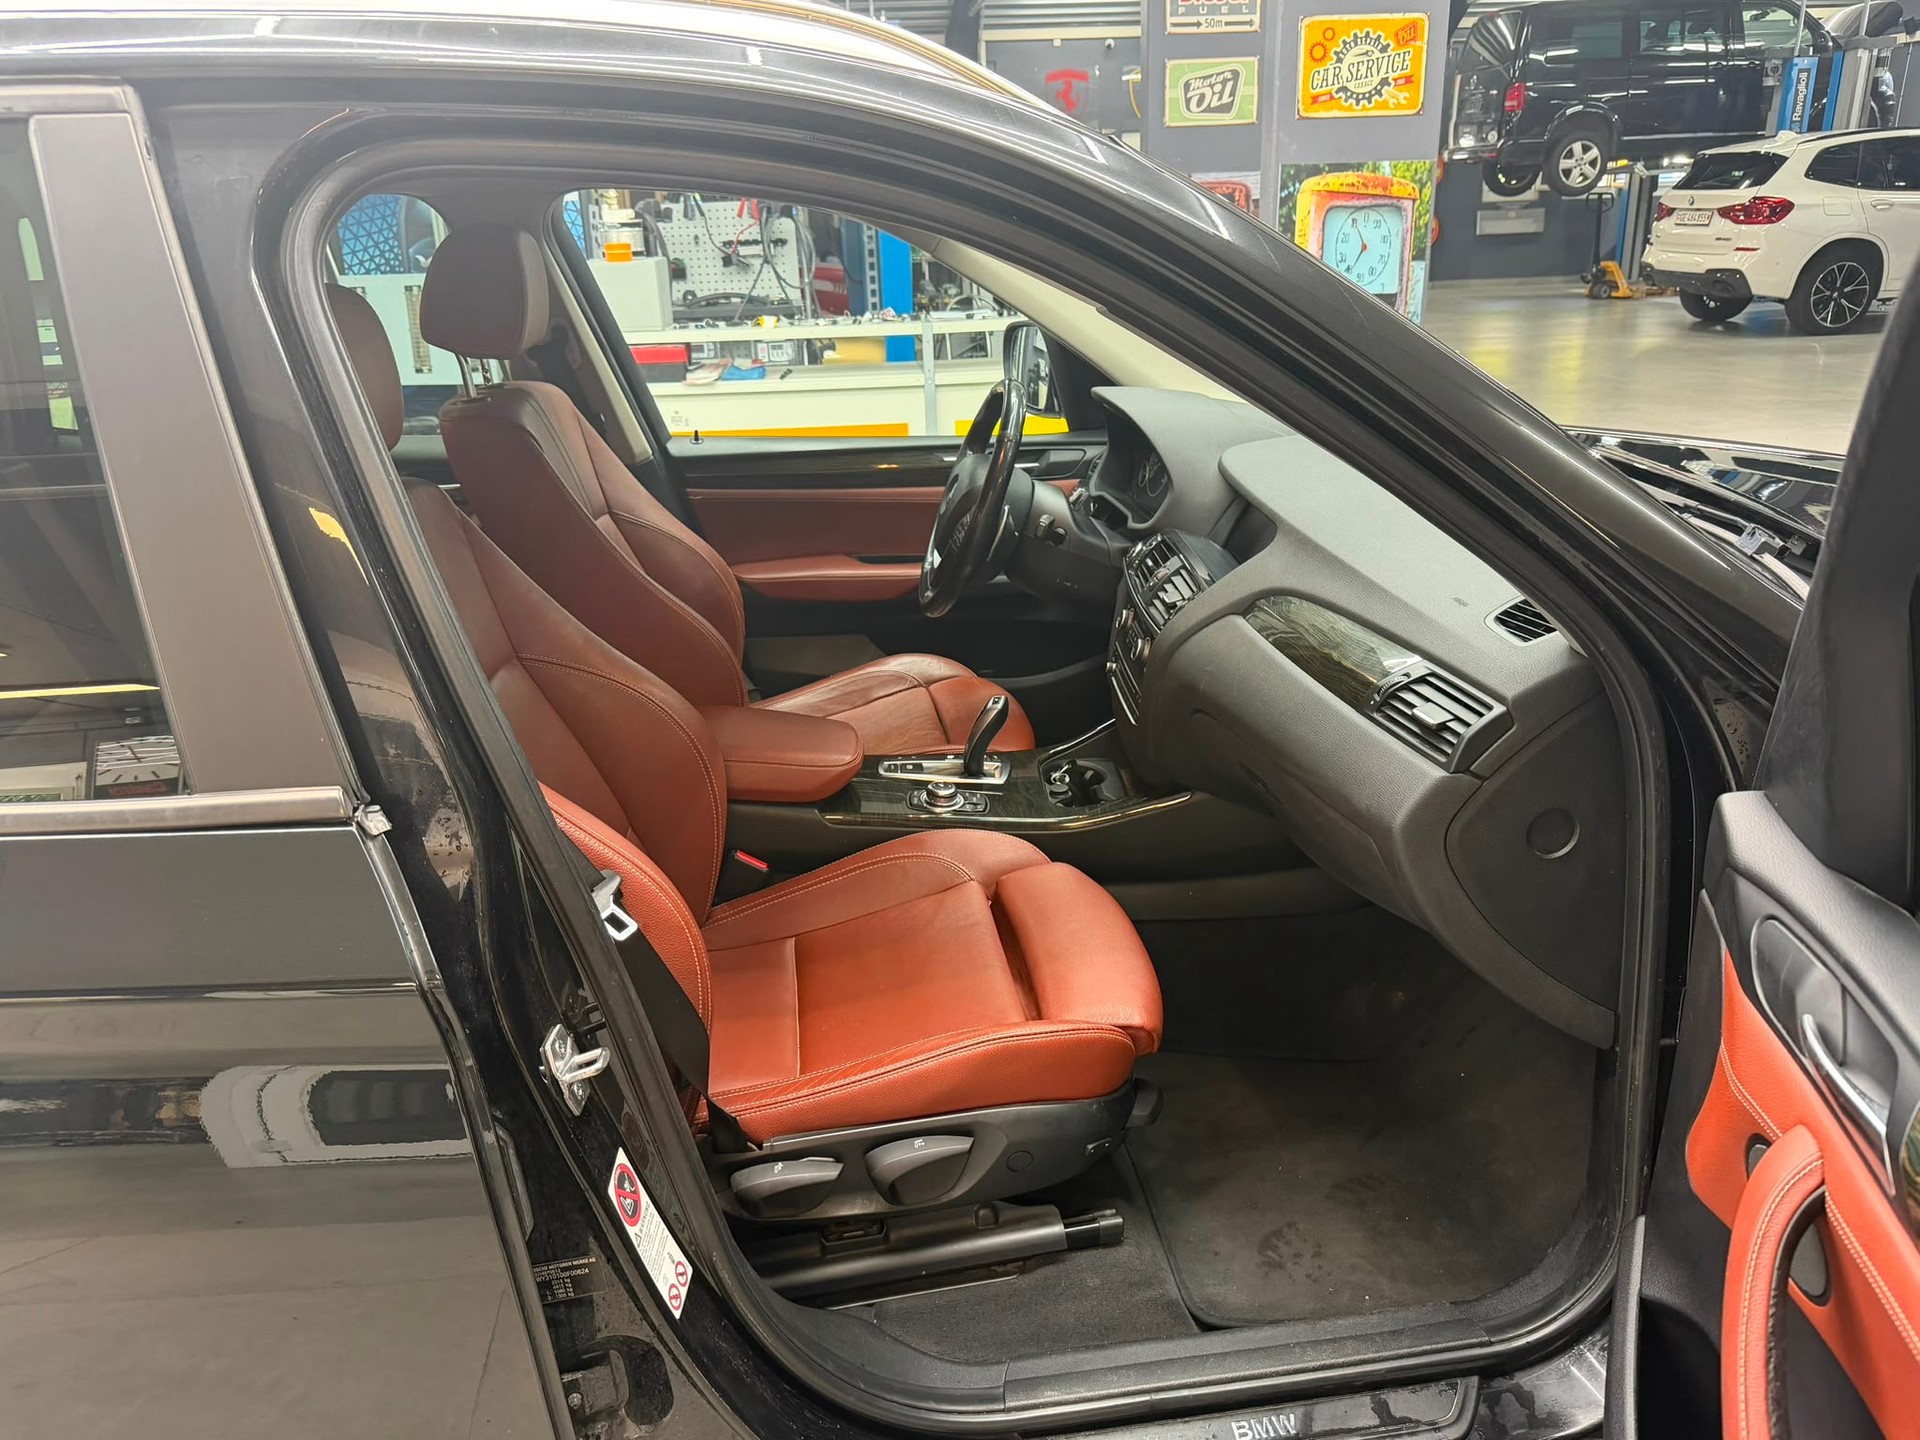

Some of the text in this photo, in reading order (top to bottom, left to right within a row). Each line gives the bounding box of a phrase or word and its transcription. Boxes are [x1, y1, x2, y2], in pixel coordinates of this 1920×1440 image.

[1204, 18, 1223, 28] 50m
[1188, 72, 1233, 91] Motor
[1311, 51, 1411, 90] CAR SERVICE
[1186, 81, 1234, 113] Oil
[1792, 72, 1808, 121] Ravaglioli
[1231, 1414, 1297, 1440] BMW
